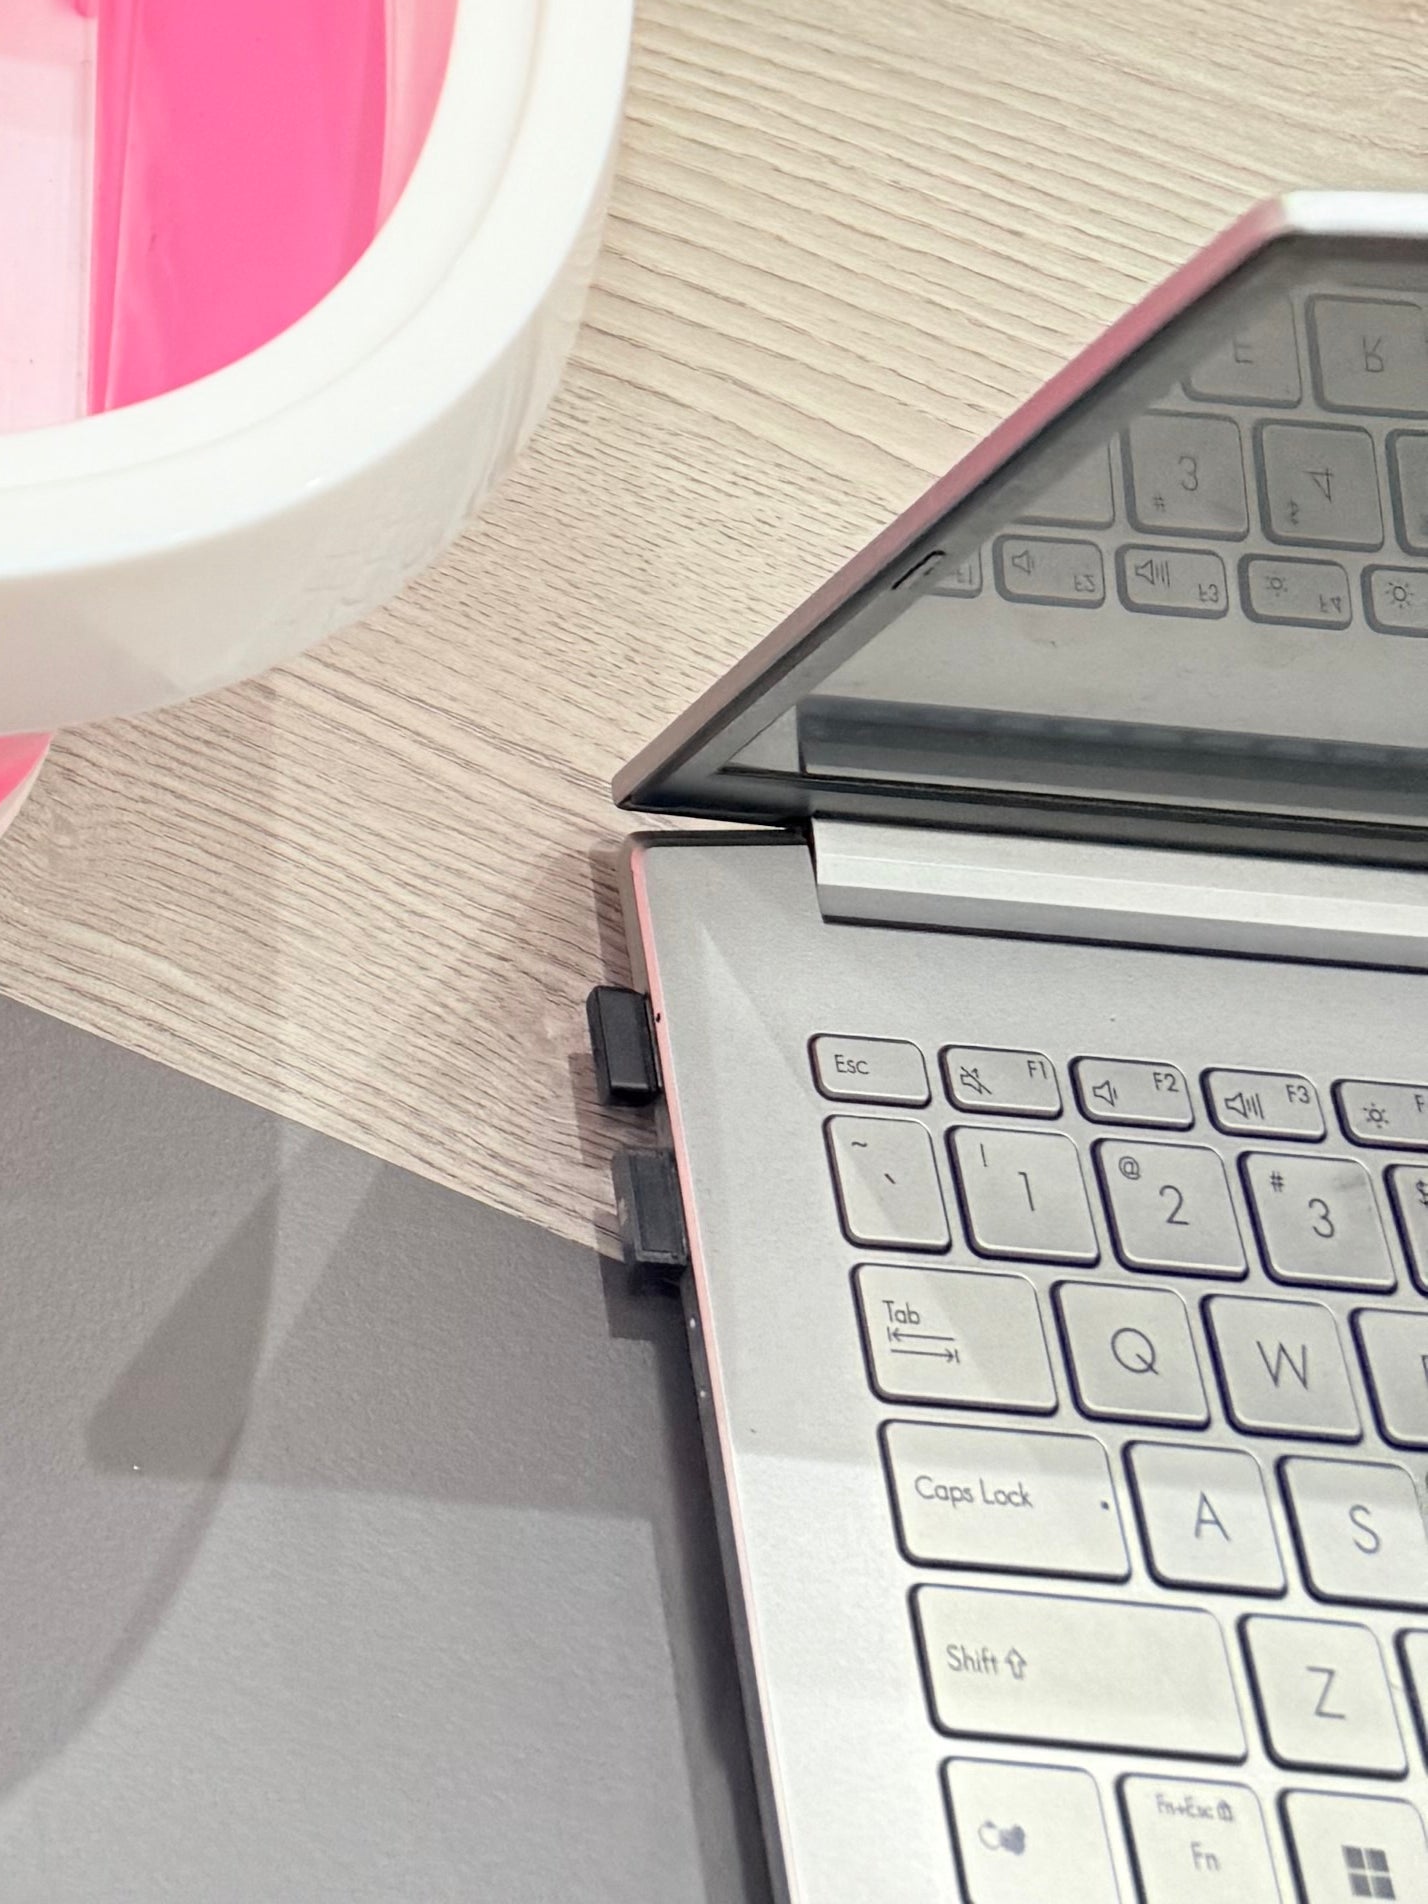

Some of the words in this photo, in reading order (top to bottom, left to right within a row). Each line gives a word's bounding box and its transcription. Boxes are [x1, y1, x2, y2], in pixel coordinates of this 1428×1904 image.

[834, 1054, 869, 1077] Esc
[1027, 1060, 1049, 1080] F1
[1153, 1072, 1181, 1094] F2
[1286, 1084, 1311, 1105] F3
[1017, 1170, 1037, 1213] 1
[1158, 1185, 1191, 1227] 2
[1306, 1198, 1336, 1239] 3
[882, 1300, 921, 1327] Tab
[1110, 1327, 1160, 1376] Q
[1256, 1339, 1310, 1390] W
[914, 1476, 973, 1509] Caps
[978, 1478, 1034, 1508] Lock
[1194, 1492, 1231, 1542] A
[1348, 1504, 1381, 1555] S
[945, 1644, 999, 1676] Shift
[1306, 1665, 1348, 1721] Z
[1190, 1839, 1222, 1873] Fn
